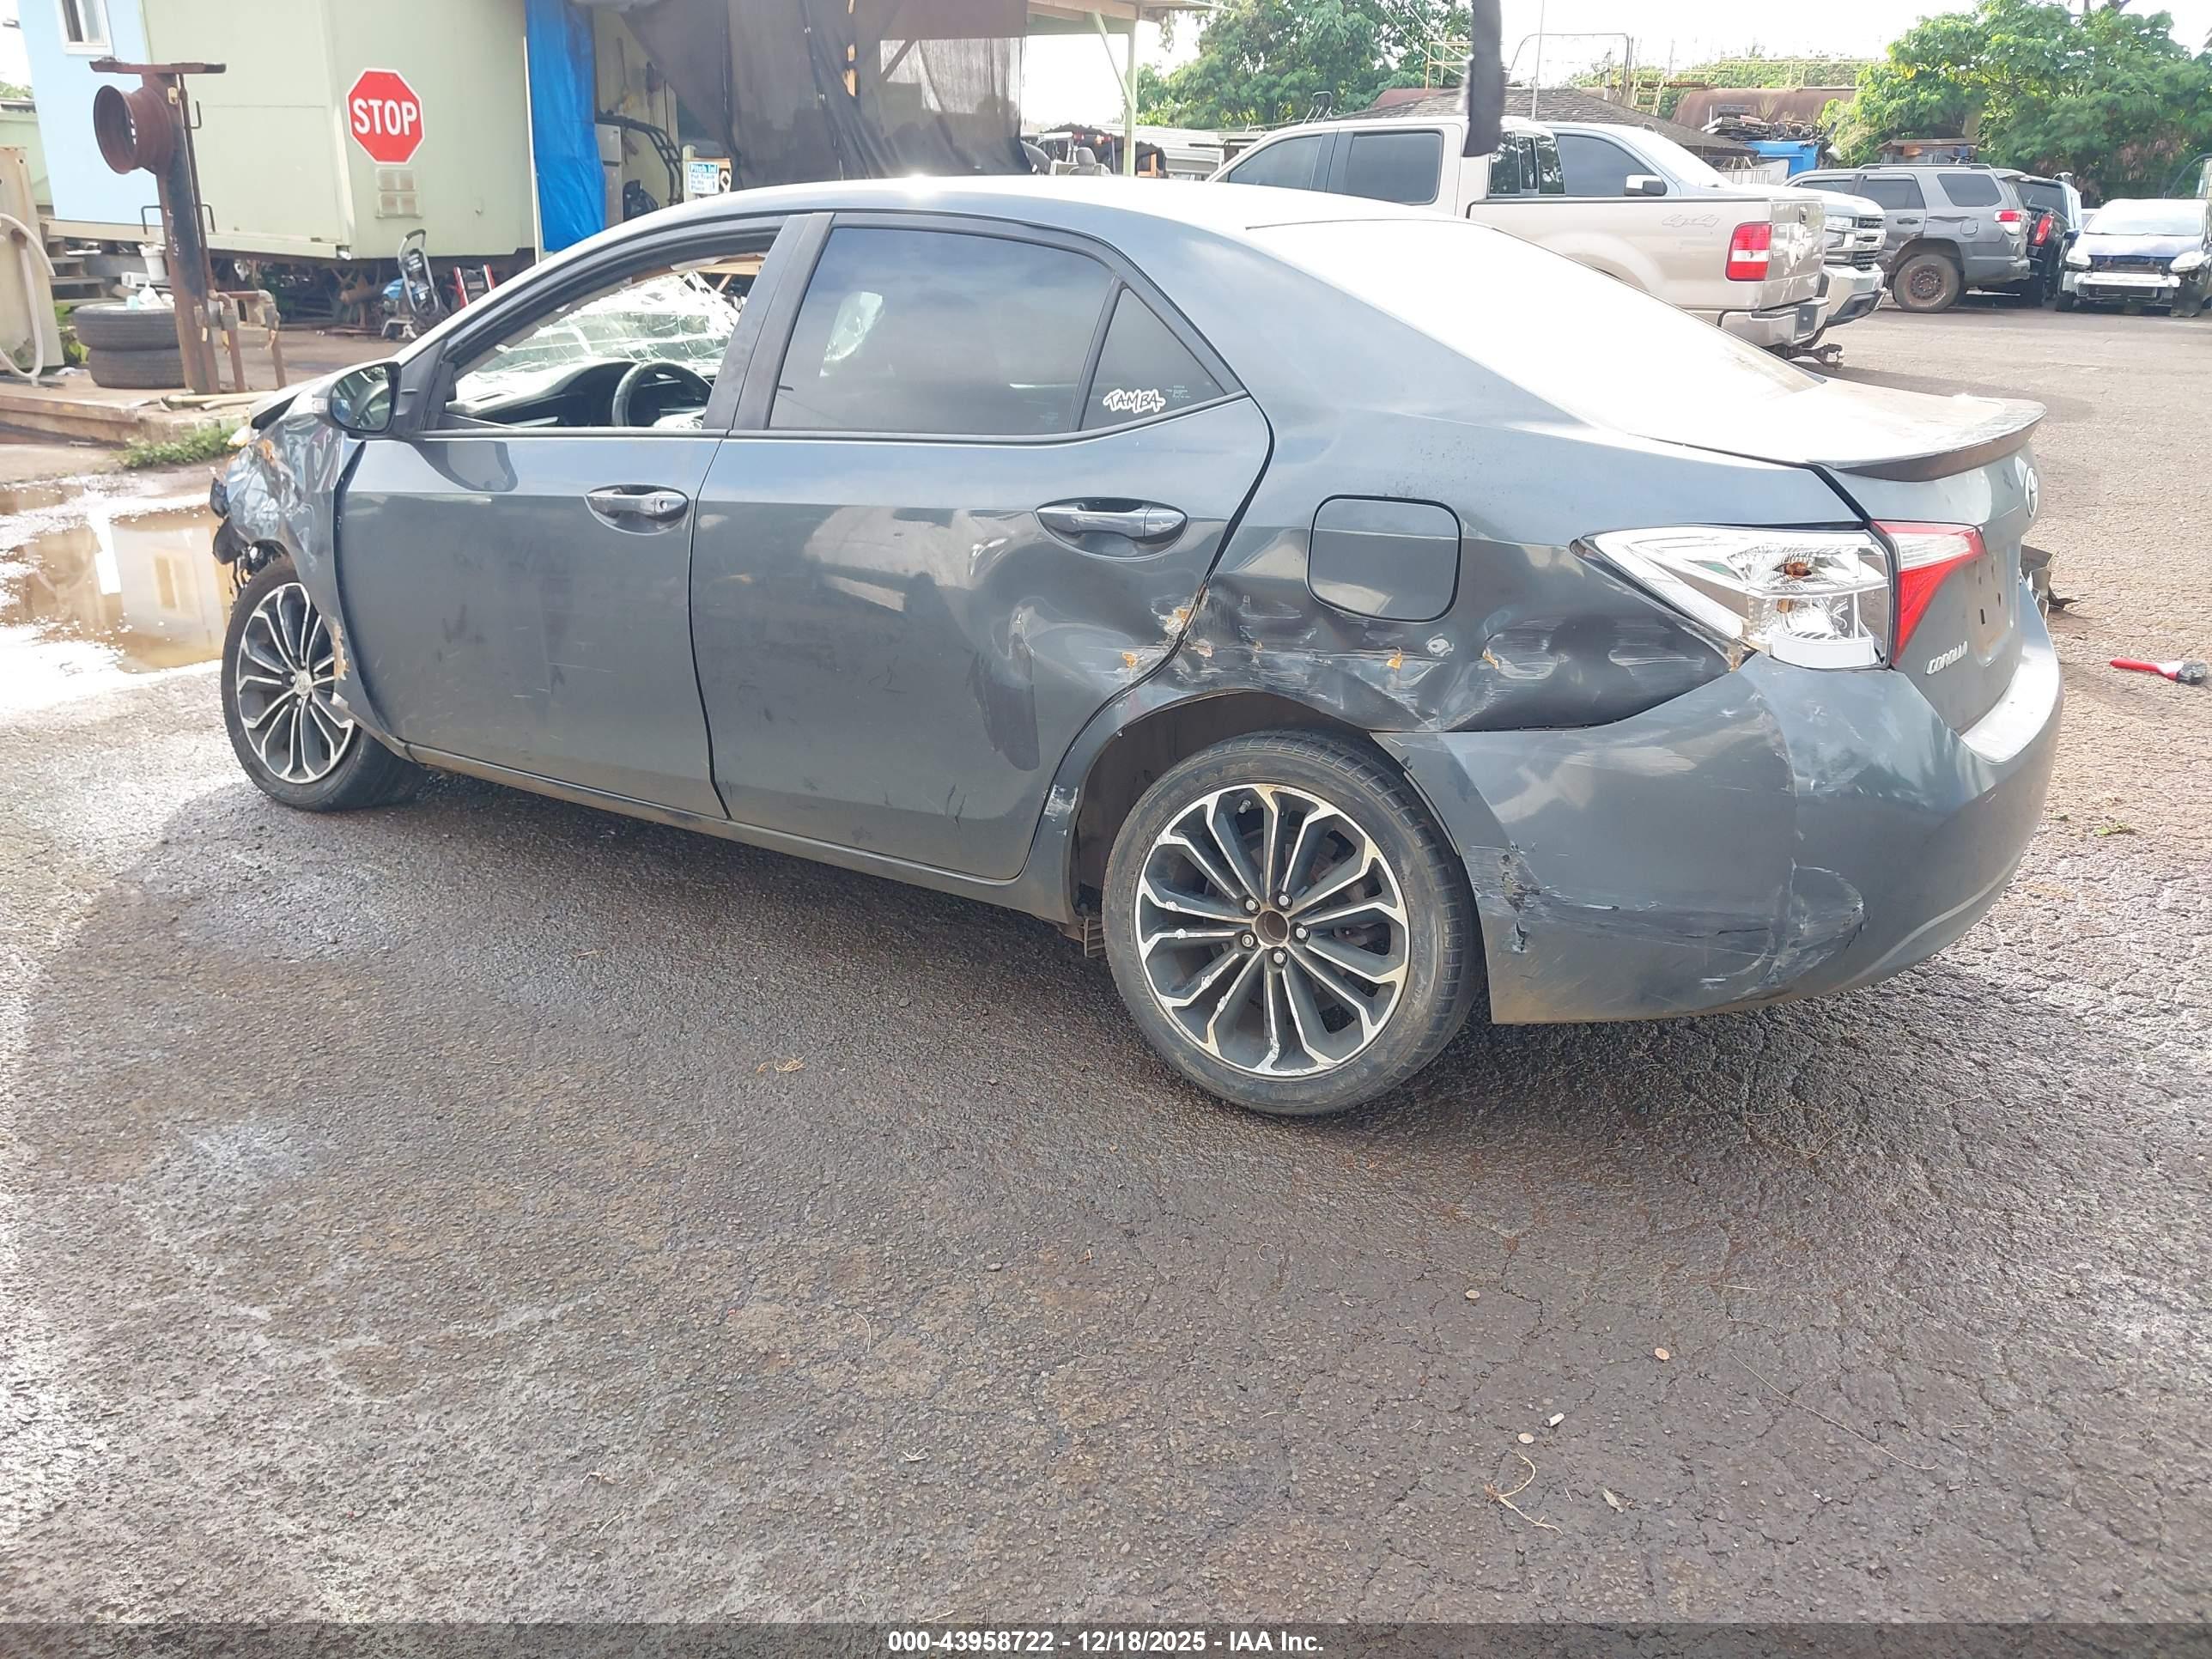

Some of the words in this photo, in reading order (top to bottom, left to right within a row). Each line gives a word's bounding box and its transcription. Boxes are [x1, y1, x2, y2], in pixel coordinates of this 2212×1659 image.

[352, 98, 418, 137] STOP
[1103, 389, 1166, 413] TAMBA
[1925, 641, 1968, 675] COROLLA
